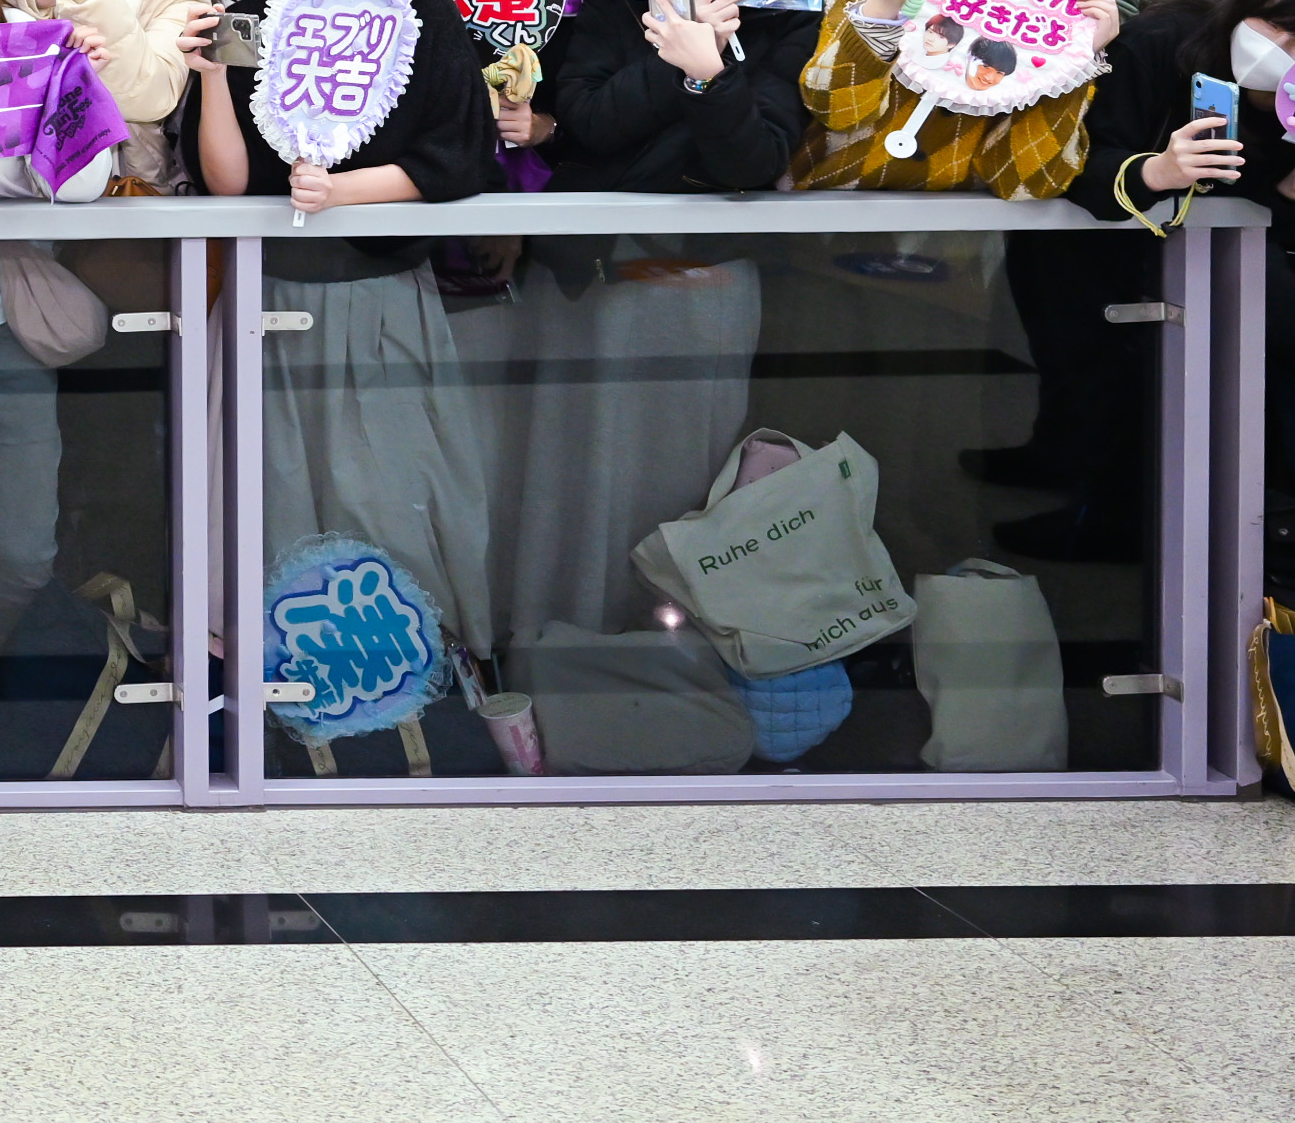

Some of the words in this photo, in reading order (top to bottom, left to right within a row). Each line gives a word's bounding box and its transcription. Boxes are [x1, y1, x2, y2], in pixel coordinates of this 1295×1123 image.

[288, 10, 397, 60] エブリ
[282, 50, 380, 116] 大吉
[698, 538, 759, 575] Ruhe
[766, 509, 816, 541] dich
[854, 577, 884, 597] für
[858, 597, 899, 621] aus
